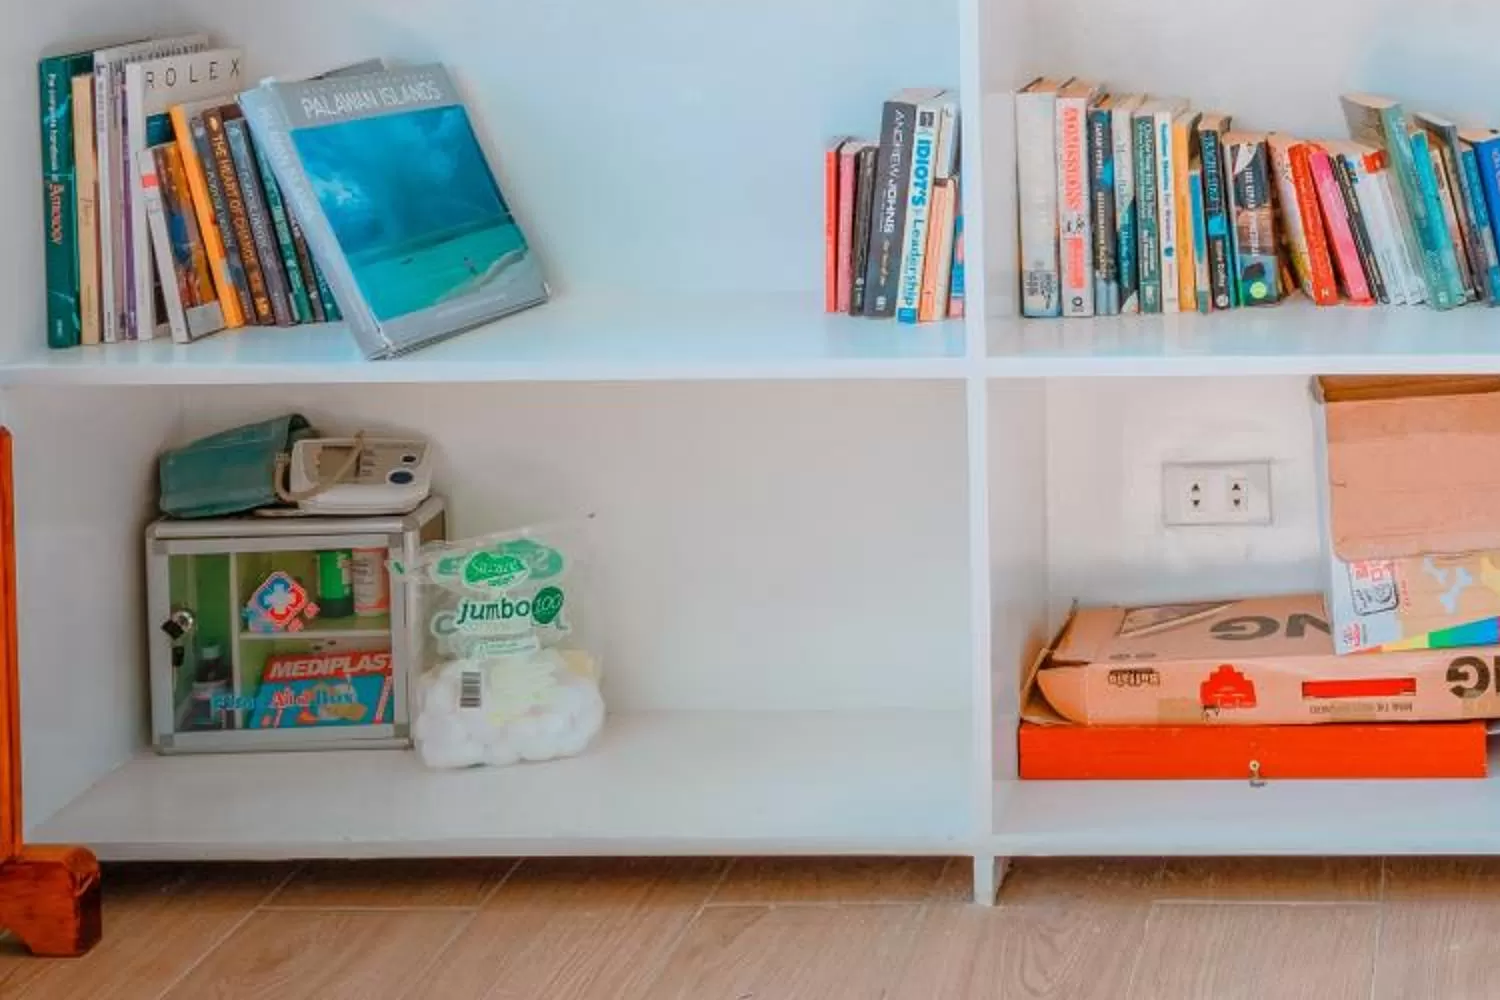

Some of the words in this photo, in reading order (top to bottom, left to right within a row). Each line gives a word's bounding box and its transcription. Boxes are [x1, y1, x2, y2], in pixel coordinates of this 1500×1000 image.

[144, 57, 241, 89] ROLEX
[911, 138, 932, 206] IDIOT'S
[883, 178, 898, 233] JOHNS
[903, 218, 925, 306] Leadership
[457, 597, 530, 625] jumbo
